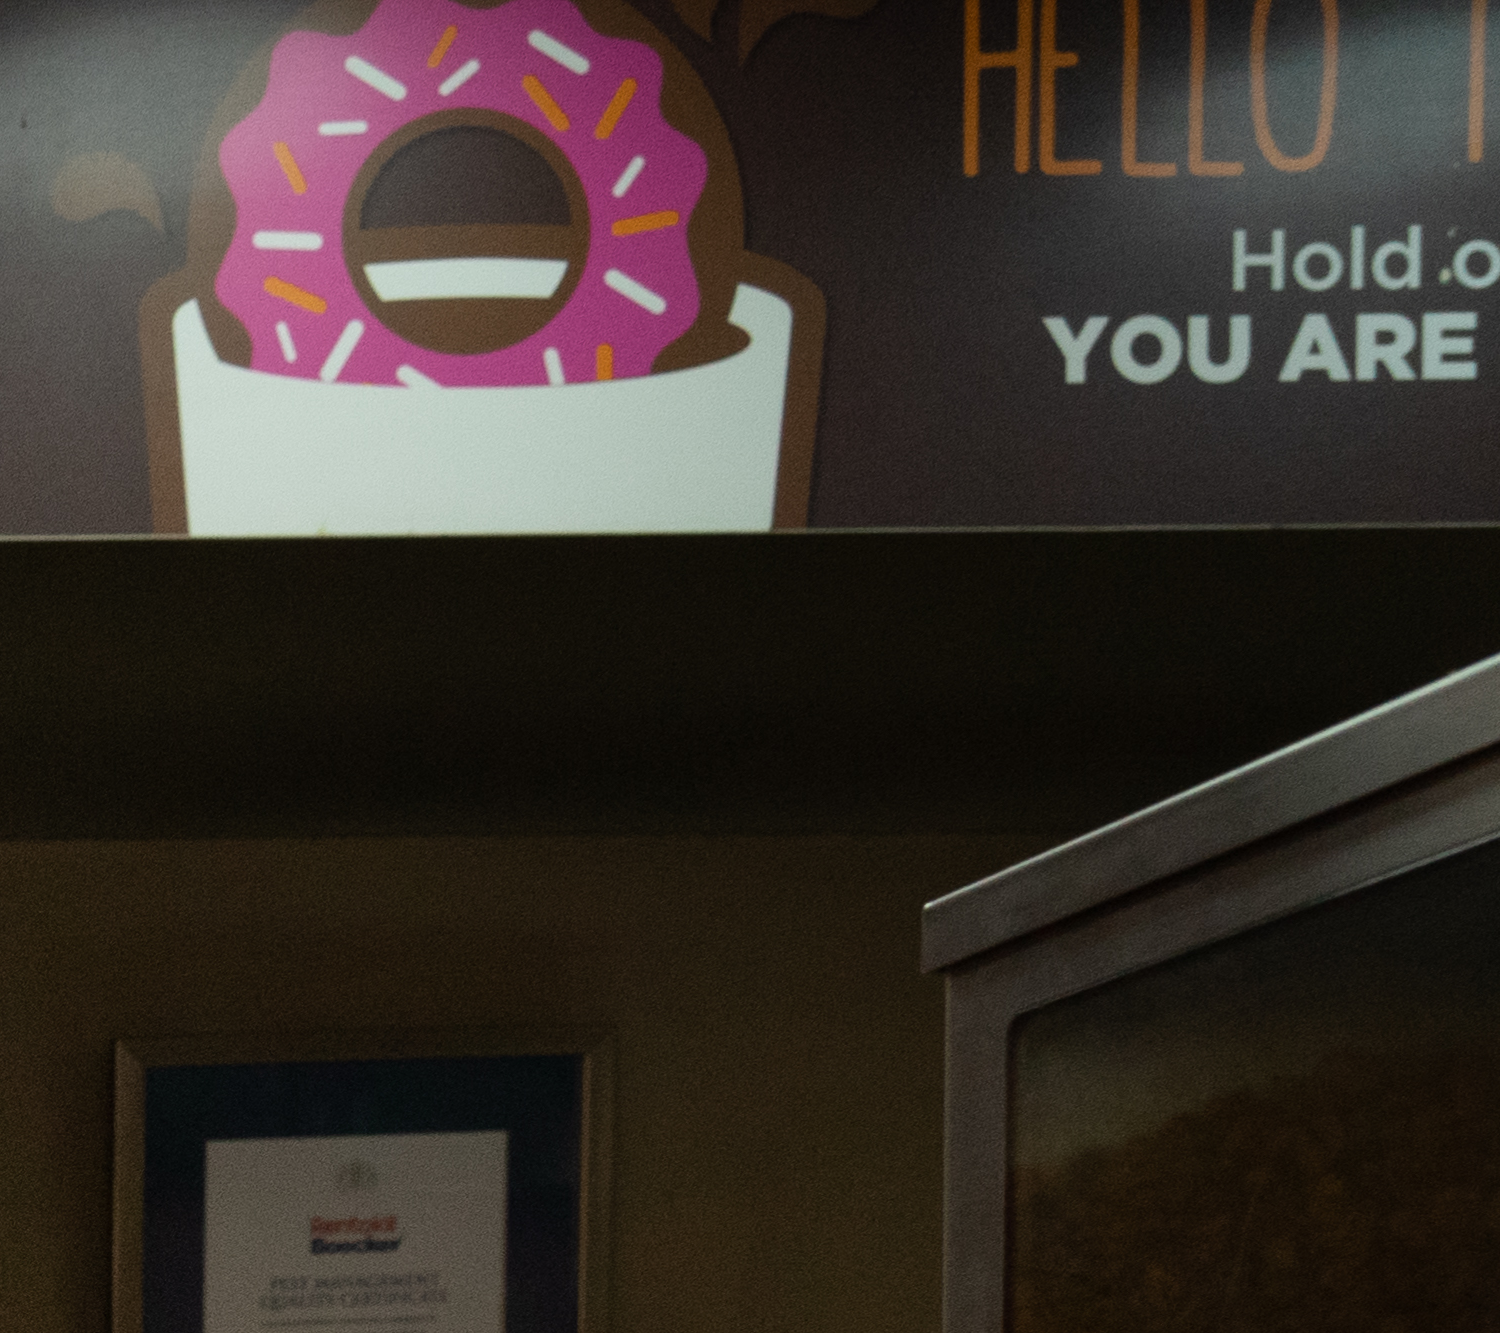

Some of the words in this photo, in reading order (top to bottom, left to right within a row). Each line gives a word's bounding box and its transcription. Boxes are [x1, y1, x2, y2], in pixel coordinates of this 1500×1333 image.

[963, 0, 1339, 177] HELLO
[1232, 225, 1422, 291] Hold
[1042, 313, 1252, 384] YOU
[1279, 312, 1479, 382] ARE
